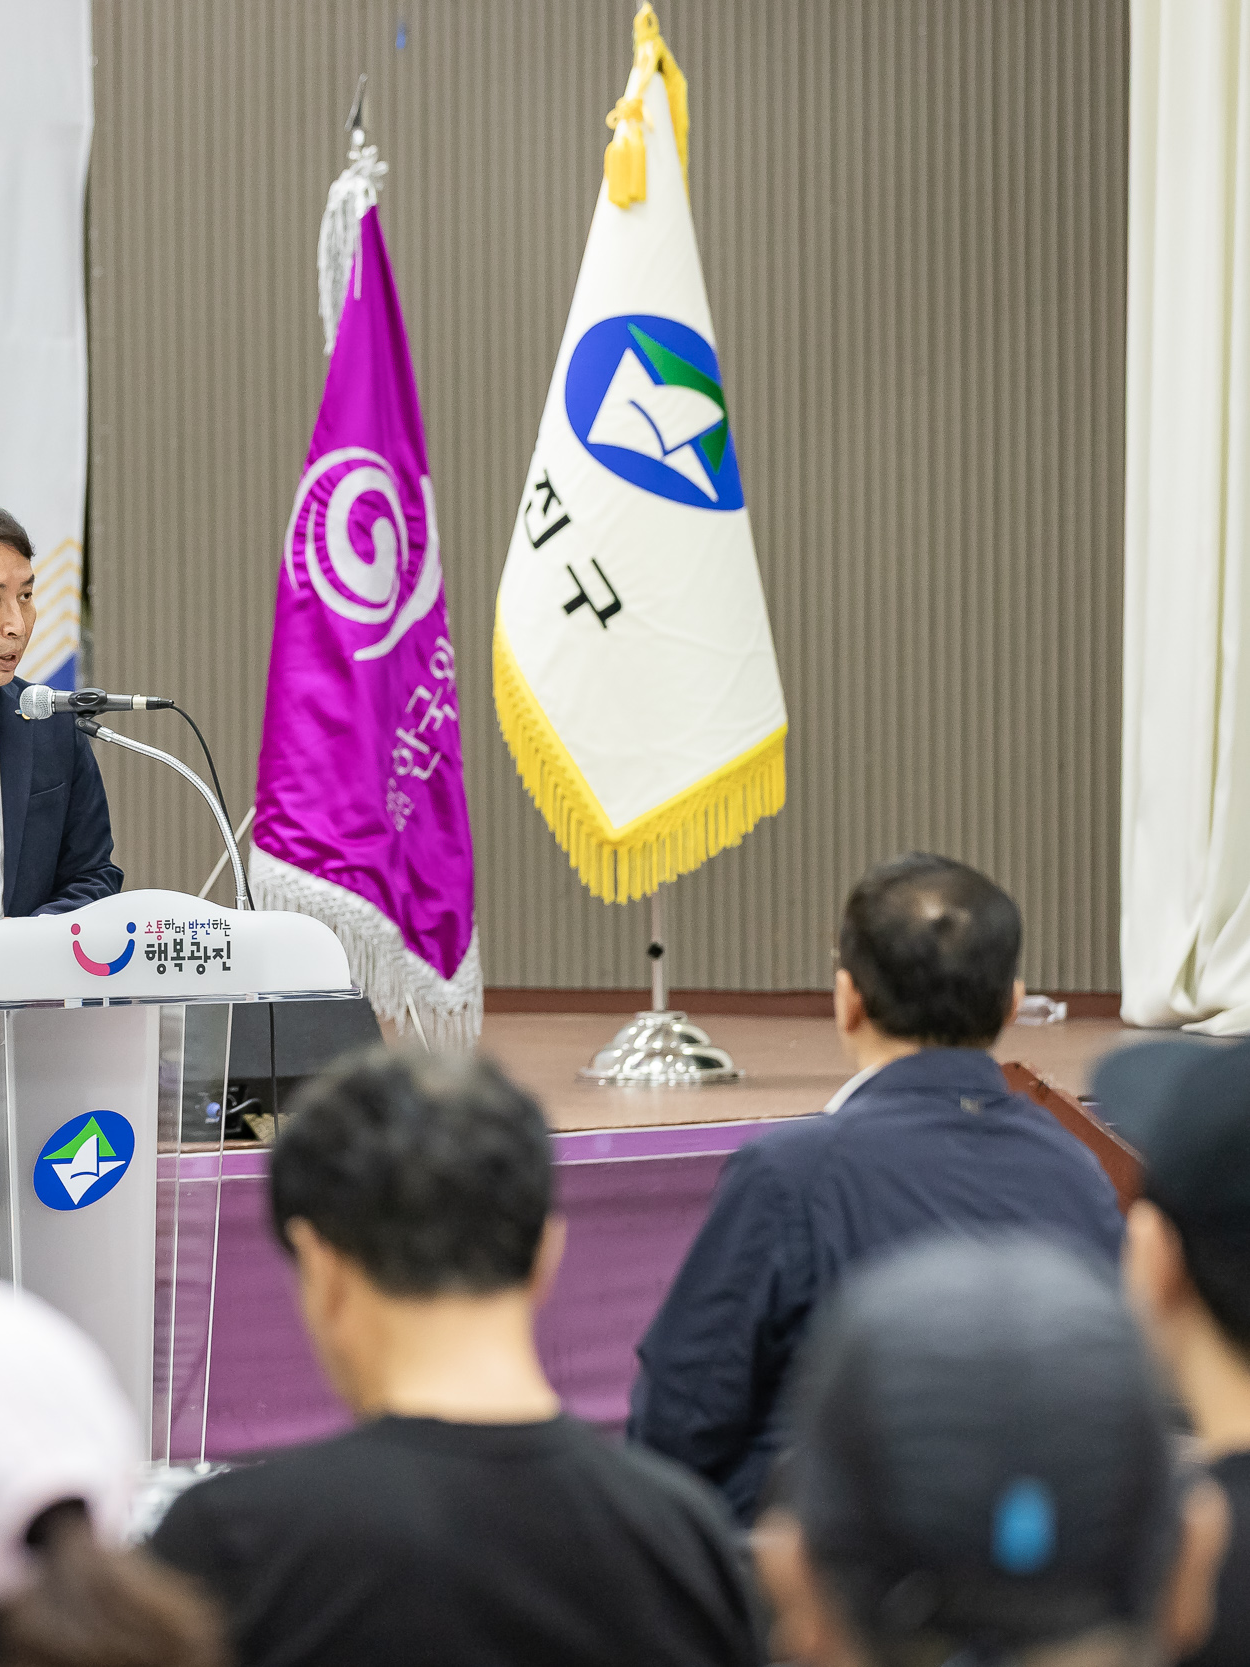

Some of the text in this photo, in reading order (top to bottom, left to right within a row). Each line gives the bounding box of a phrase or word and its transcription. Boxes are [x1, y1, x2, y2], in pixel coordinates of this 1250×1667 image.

[144, 918, 231, 941] 소통하며 발전하는
[144, 938, 231, 975] 행복광진
